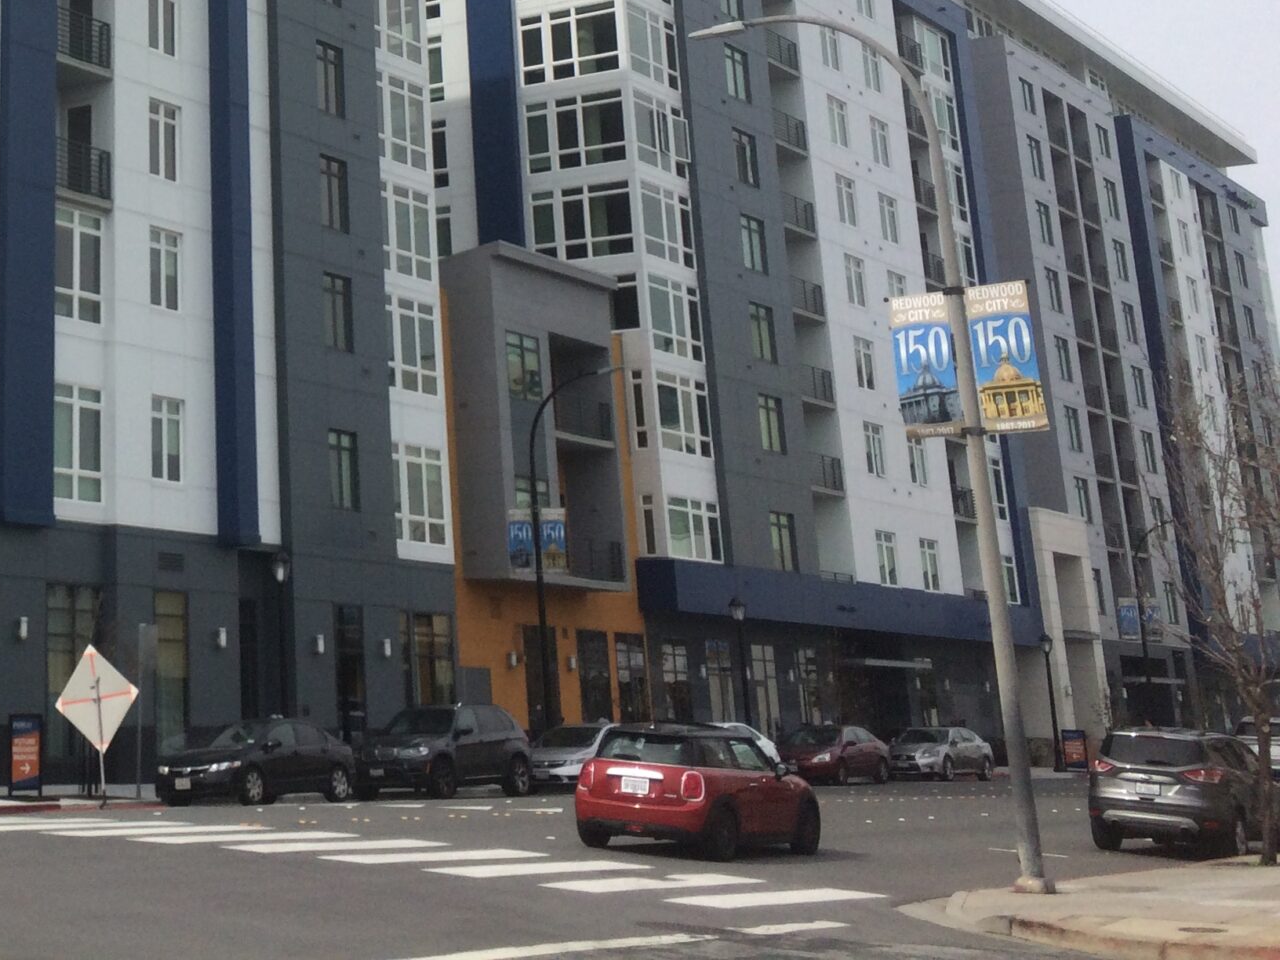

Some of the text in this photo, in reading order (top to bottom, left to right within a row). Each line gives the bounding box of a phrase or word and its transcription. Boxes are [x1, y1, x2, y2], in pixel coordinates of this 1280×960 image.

[968, 283, 1023, 300] REDWOOD
[892, 293, 944, 311] REDWOOD
[985, 298, 1009, 312] CITY
[908, 309, 930, 322] CITY
[895, 326, 949, 375] 150
[973, 317, 1031, 368] 150
[510, 523, 532, 541] 150
[542, 522, 565, 542] 150
